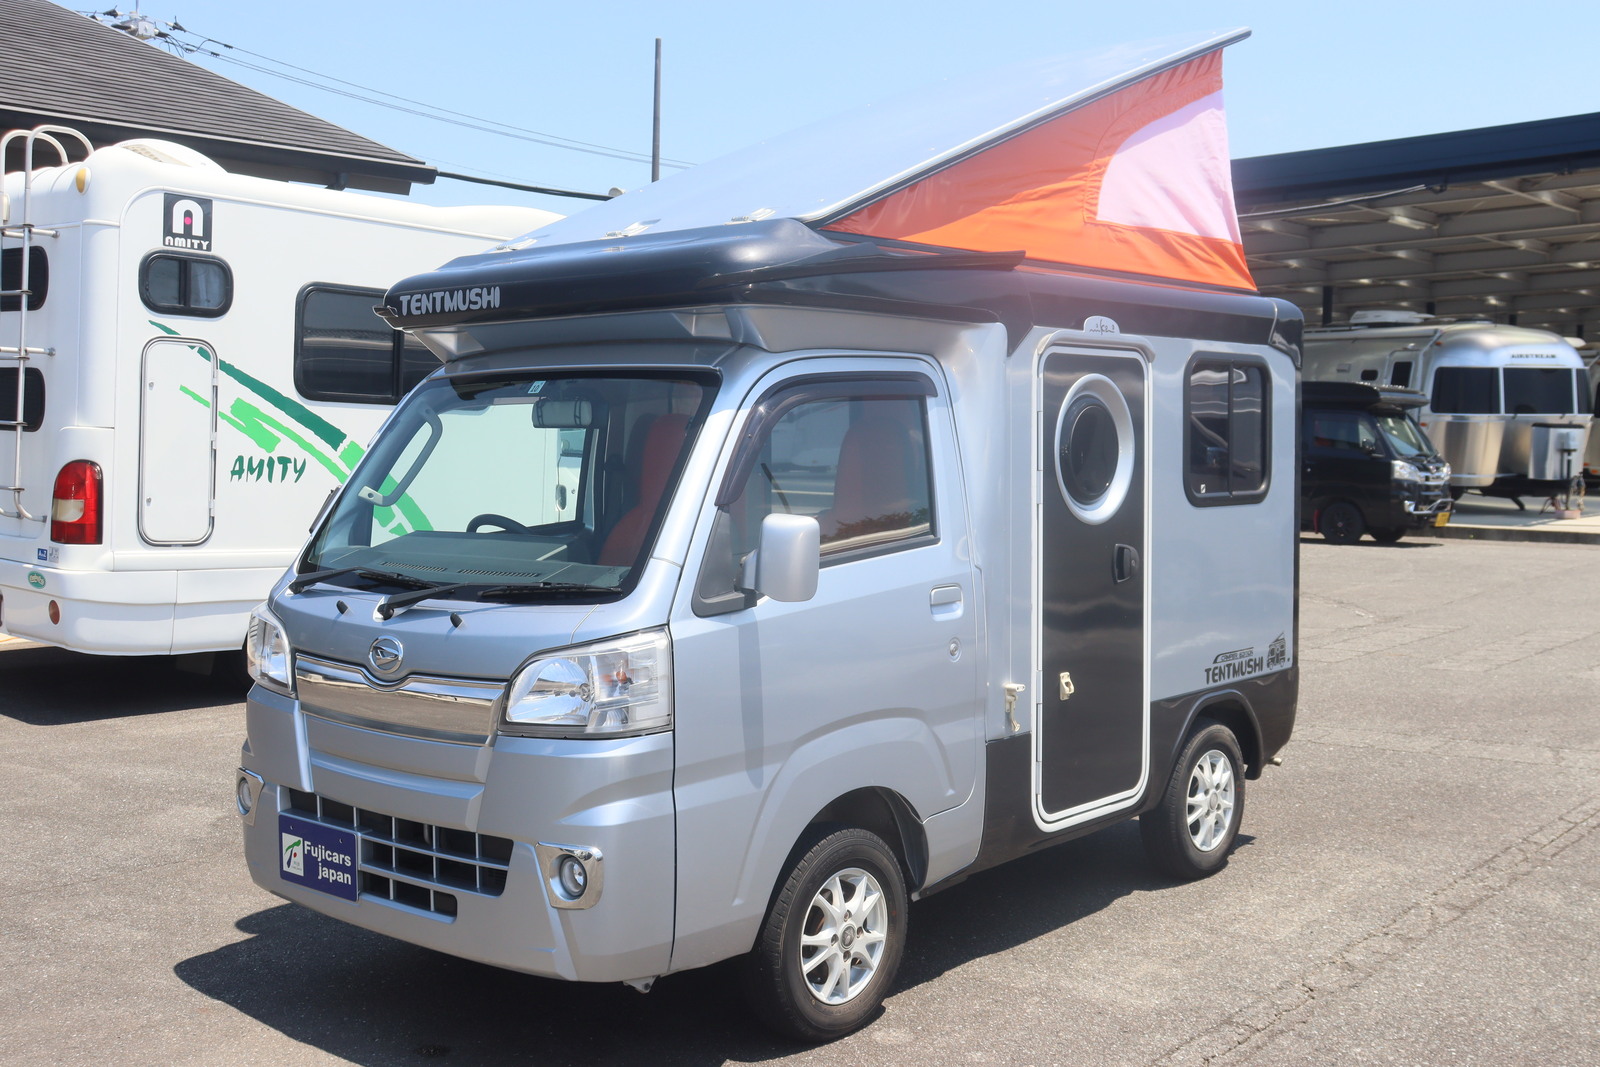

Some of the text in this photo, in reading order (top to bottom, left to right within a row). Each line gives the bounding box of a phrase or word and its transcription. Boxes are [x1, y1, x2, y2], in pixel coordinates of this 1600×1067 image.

[165, 235, 210, 250] AMITY
[400, 286, 500, 316] TENTMUSHI
[230, 454, 307, 484] AMITY
[1205, 657, 1263, 684] TENTMUSHI
[304, 840, 352, 866] Fujicars
[317, 863, 351, 885] japan
